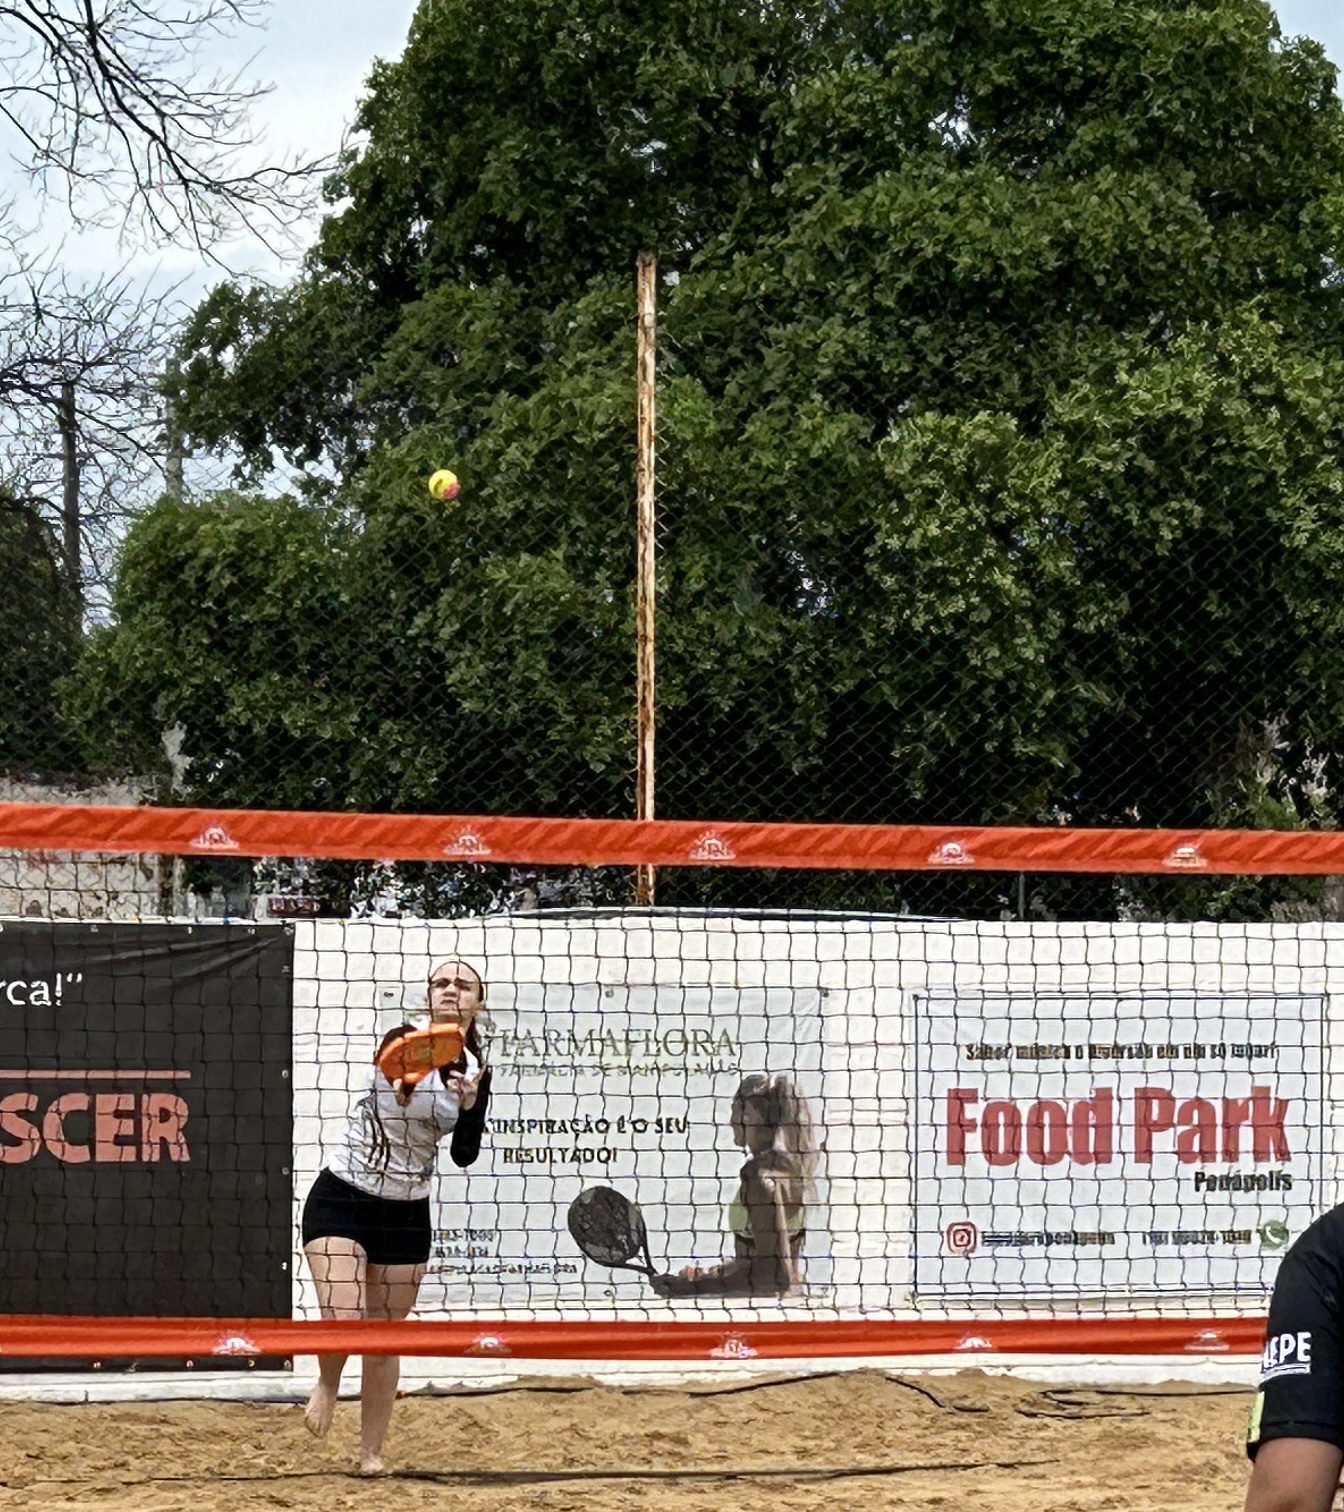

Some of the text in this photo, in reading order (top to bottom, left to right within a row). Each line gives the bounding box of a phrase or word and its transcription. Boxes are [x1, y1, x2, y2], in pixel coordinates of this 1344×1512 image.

[500, 1028, 737, 1058] FARMAFLORA
[655, 1117, 688, 1134] SEU
[945, 1086, 1293, 1166] Food Park
